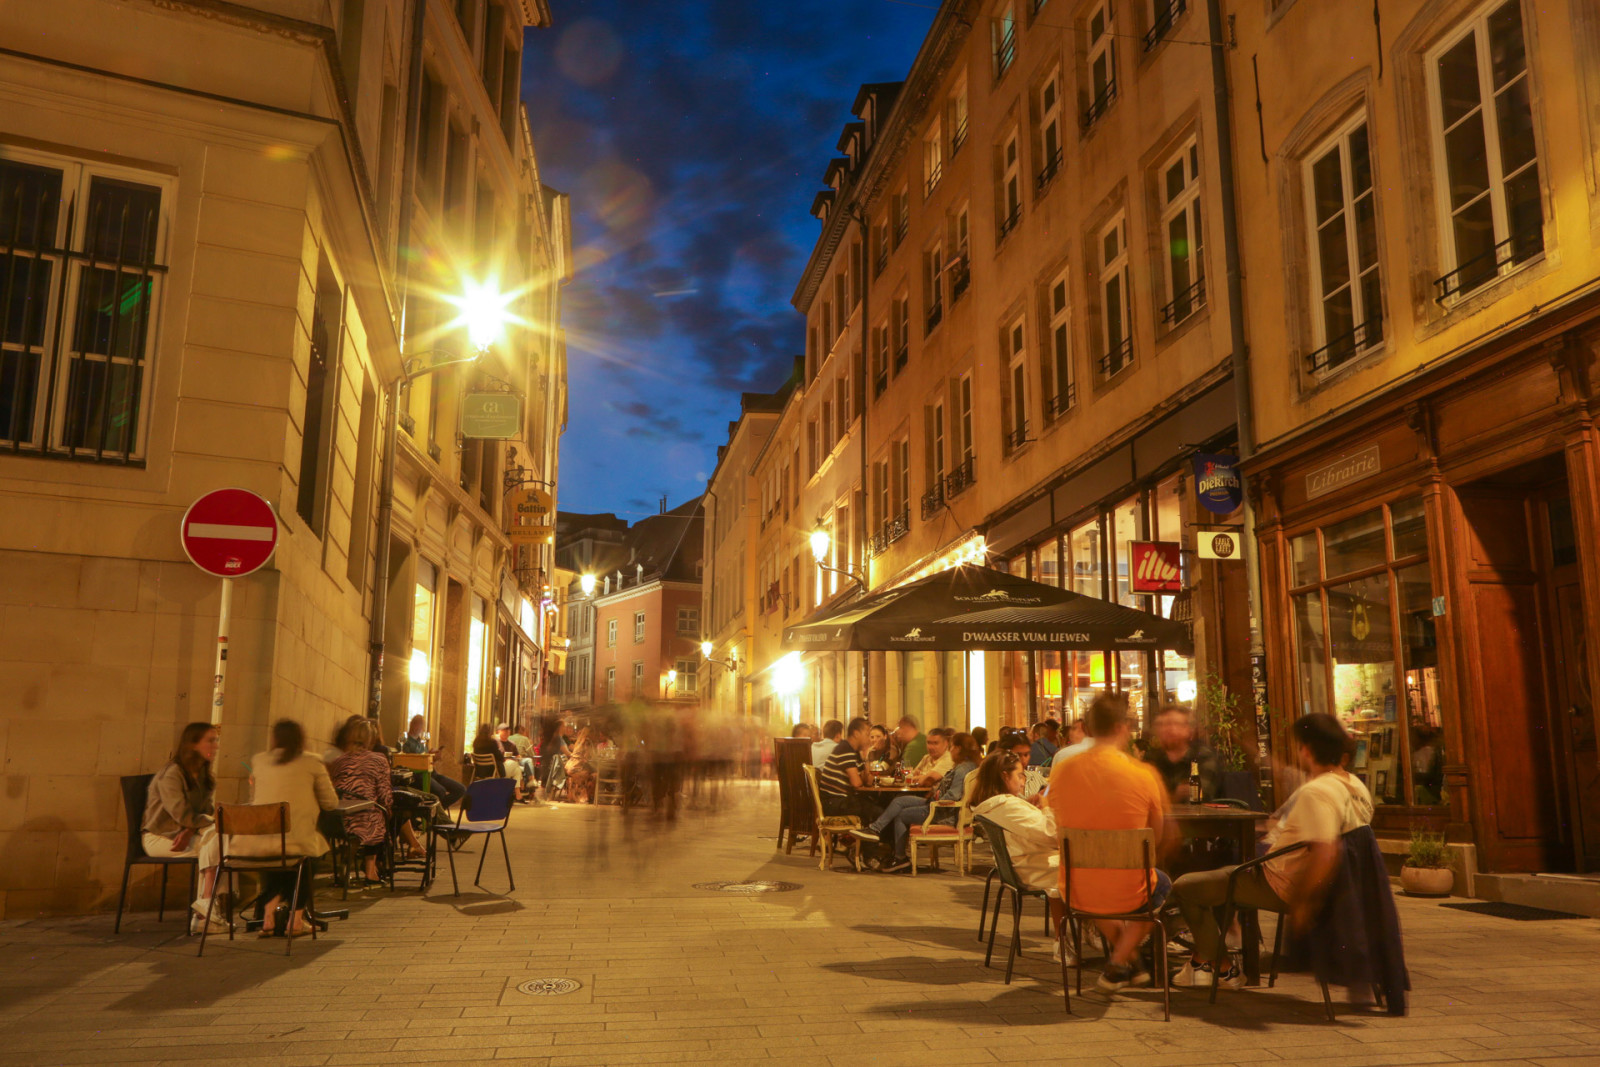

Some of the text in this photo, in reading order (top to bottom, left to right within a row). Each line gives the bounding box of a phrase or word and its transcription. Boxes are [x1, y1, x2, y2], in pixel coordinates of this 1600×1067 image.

[1199, 474, 1240, 495] Diekirch
[1310, 455, 1376, 493] Librairie
[517, 503, 546, 513] Battin
[1137, 551, 1178, 588] illy
[962, 632, 1090, 643] D'WAASSER VUM LIEWEN
